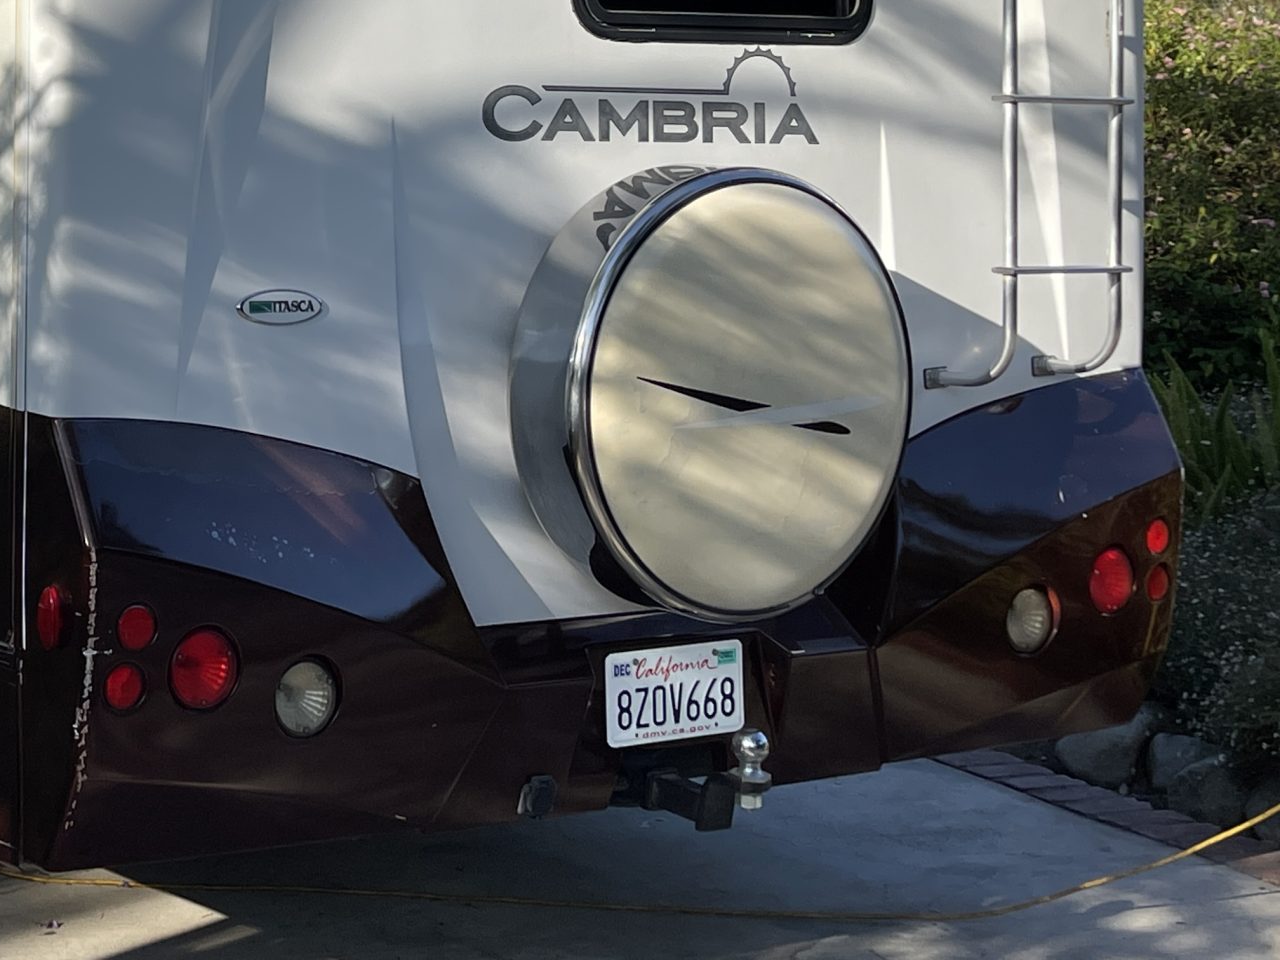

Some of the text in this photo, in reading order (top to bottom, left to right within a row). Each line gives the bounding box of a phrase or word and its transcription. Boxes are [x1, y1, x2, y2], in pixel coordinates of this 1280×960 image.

[482, 85, 820, 145] CAMBRIA
[273, 300, 314, 313] ITASCA
[614, 664, 631, 677] DEC
[635, 656, 717, 682] California
[617, 677, 735, 731] 8ZOV668
[642, 724, 712, 739] dmv.ca.gov
